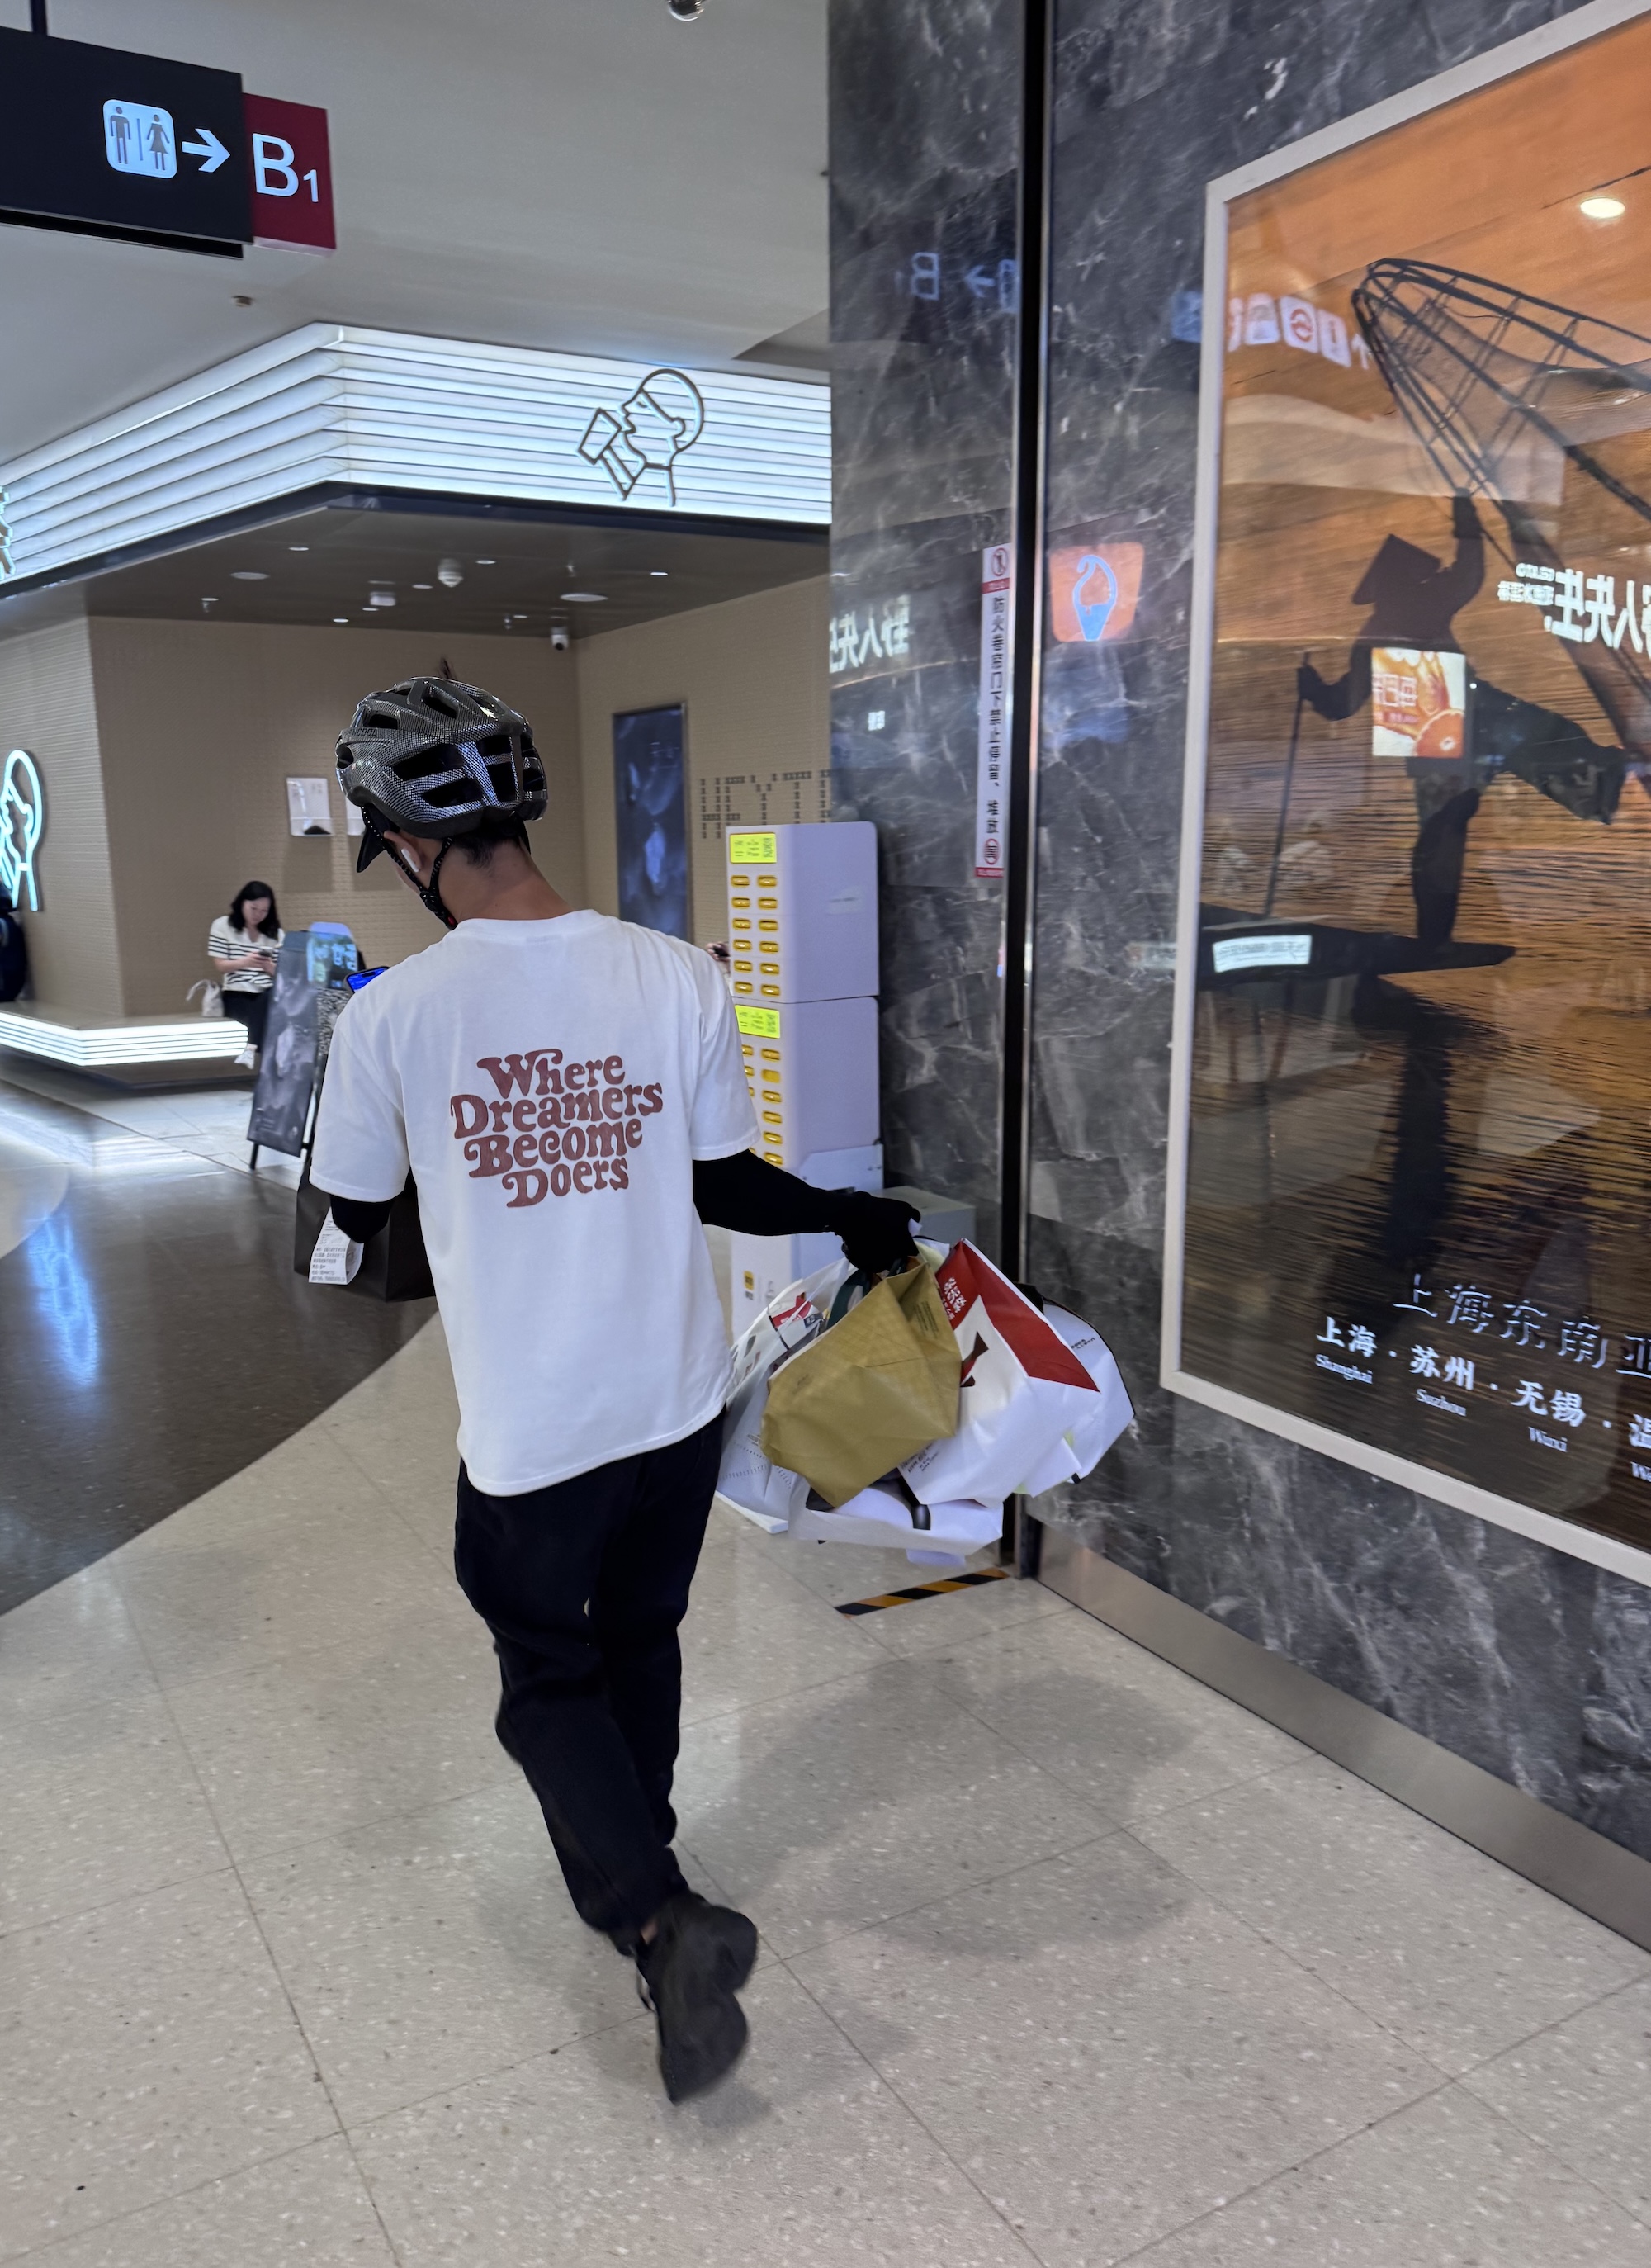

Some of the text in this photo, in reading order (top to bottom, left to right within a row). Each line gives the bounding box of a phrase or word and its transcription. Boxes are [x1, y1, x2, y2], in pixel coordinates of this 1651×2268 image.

[252, 132, 319, 203] B1
[476, 1048, 626, 1100] Where
[450, 1082, 664, 1139] Dreamers
[463, 1118, 643, 1178] Become
[501, 1157, 630, 1208] Doers
[1314, 1353, 1374, 1385] Shanghai
[1316, 1315, 1378, 1358] 上海
[1408, 1343, 1475, 1391] 苏州
[1510, 1379, 1587, 1428] 无锡
